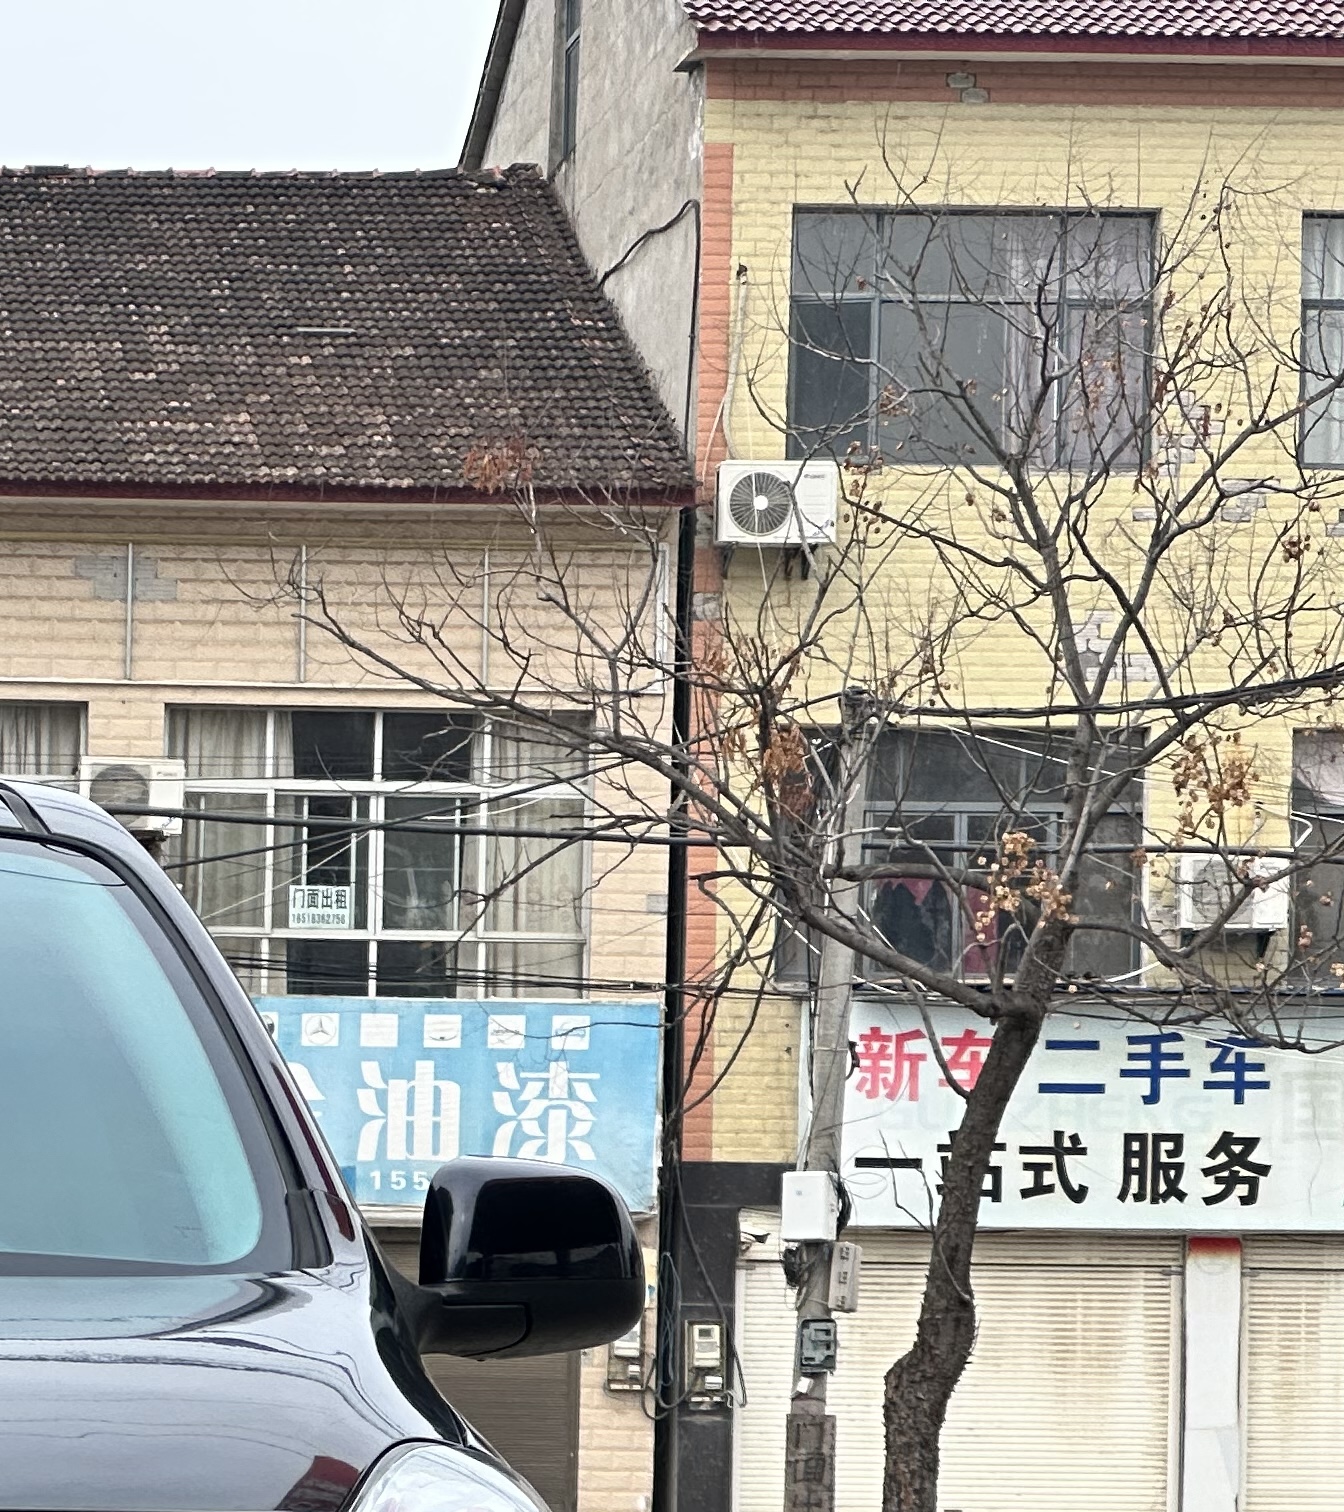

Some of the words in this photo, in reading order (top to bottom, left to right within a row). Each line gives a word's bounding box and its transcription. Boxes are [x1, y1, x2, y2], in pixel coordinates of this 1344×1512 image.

[292, 887, 348, 910] 门面出租
[1038, 1031, 1271, 1105] 二手车
[1117, 1131, 1272, 1206] 服务
